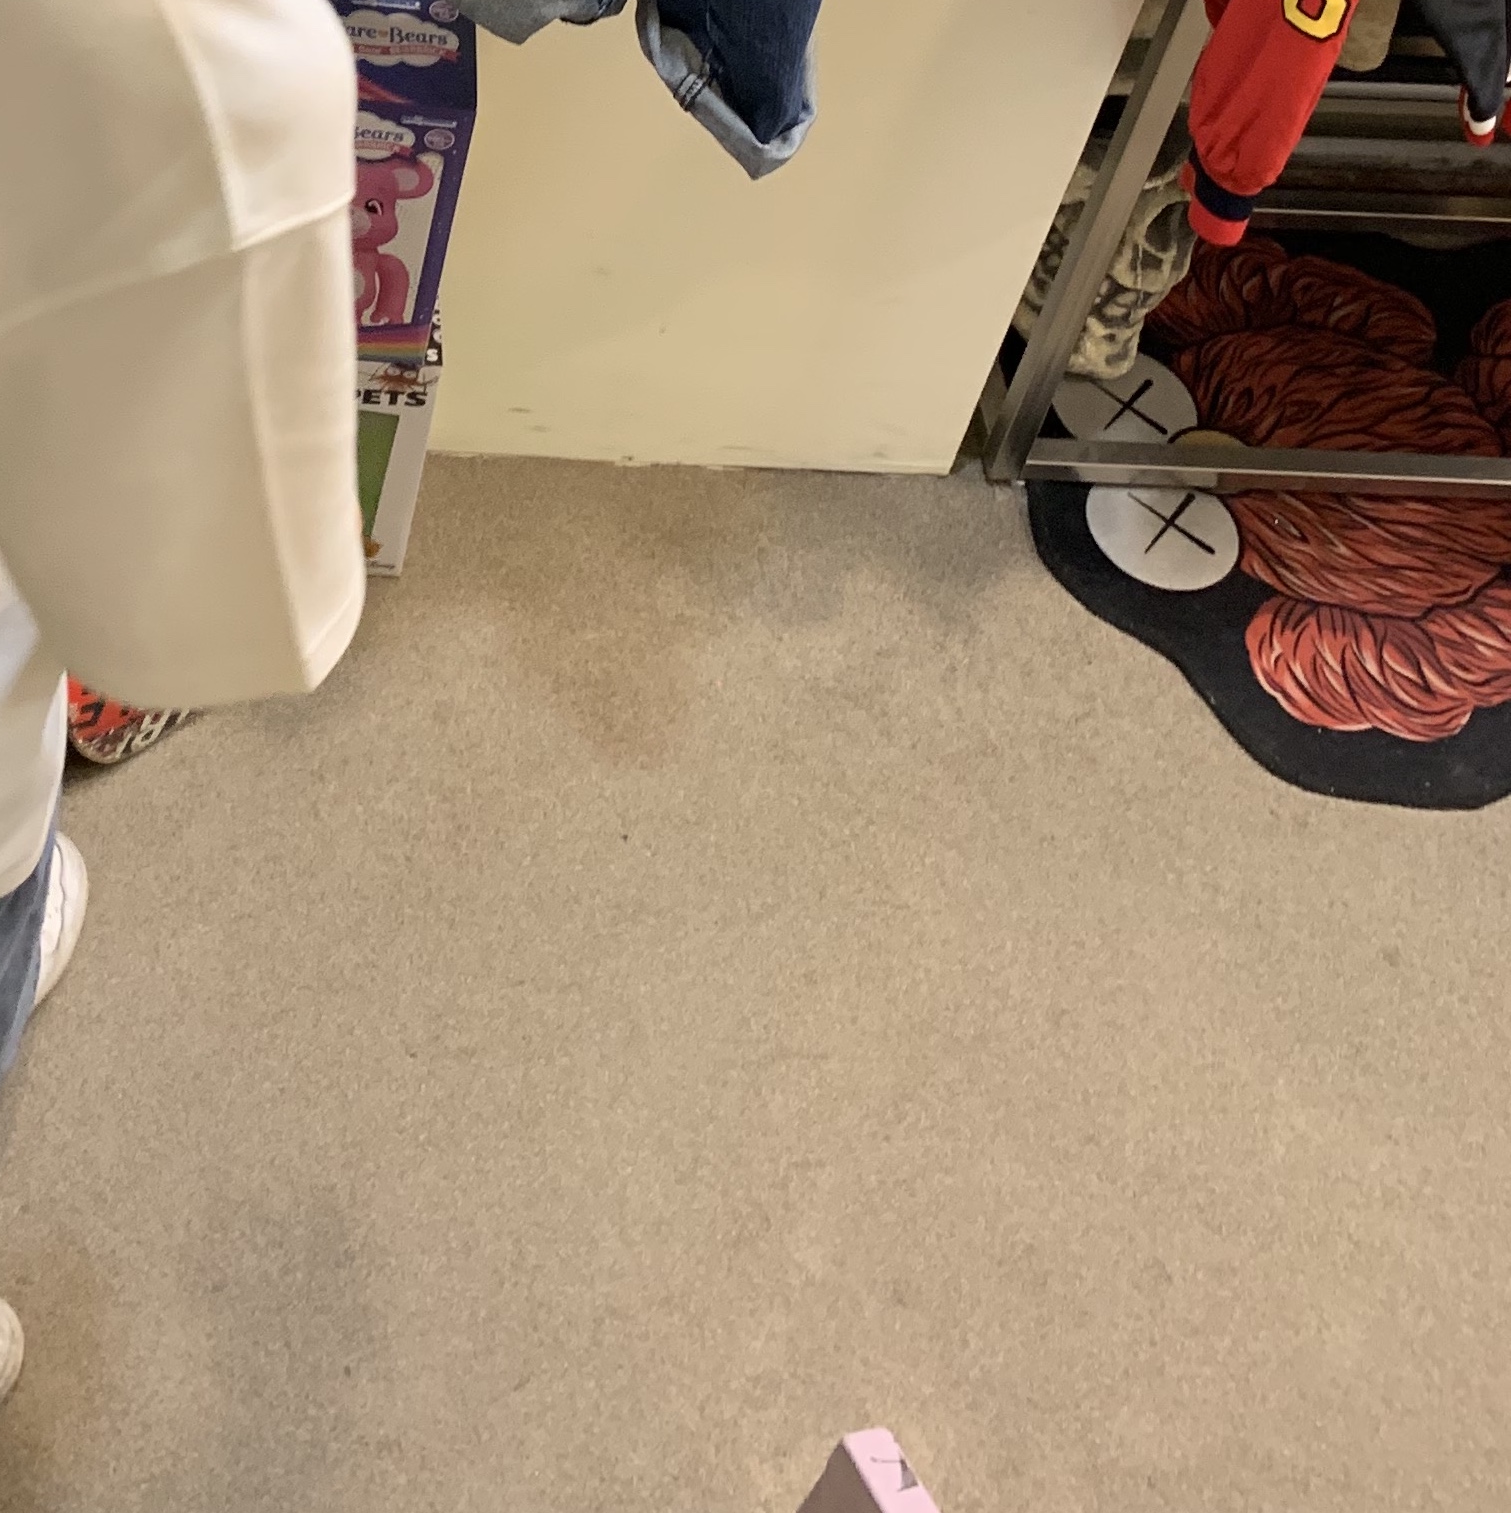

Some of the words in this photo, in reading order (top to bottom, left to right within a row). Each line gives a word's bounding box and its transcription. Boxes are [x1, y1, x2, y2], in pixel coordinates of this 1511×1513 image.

[347, 26, 377, 39] are
[390, 26, 448, 45] Bears
[356, 389, 428, 408] ETS
